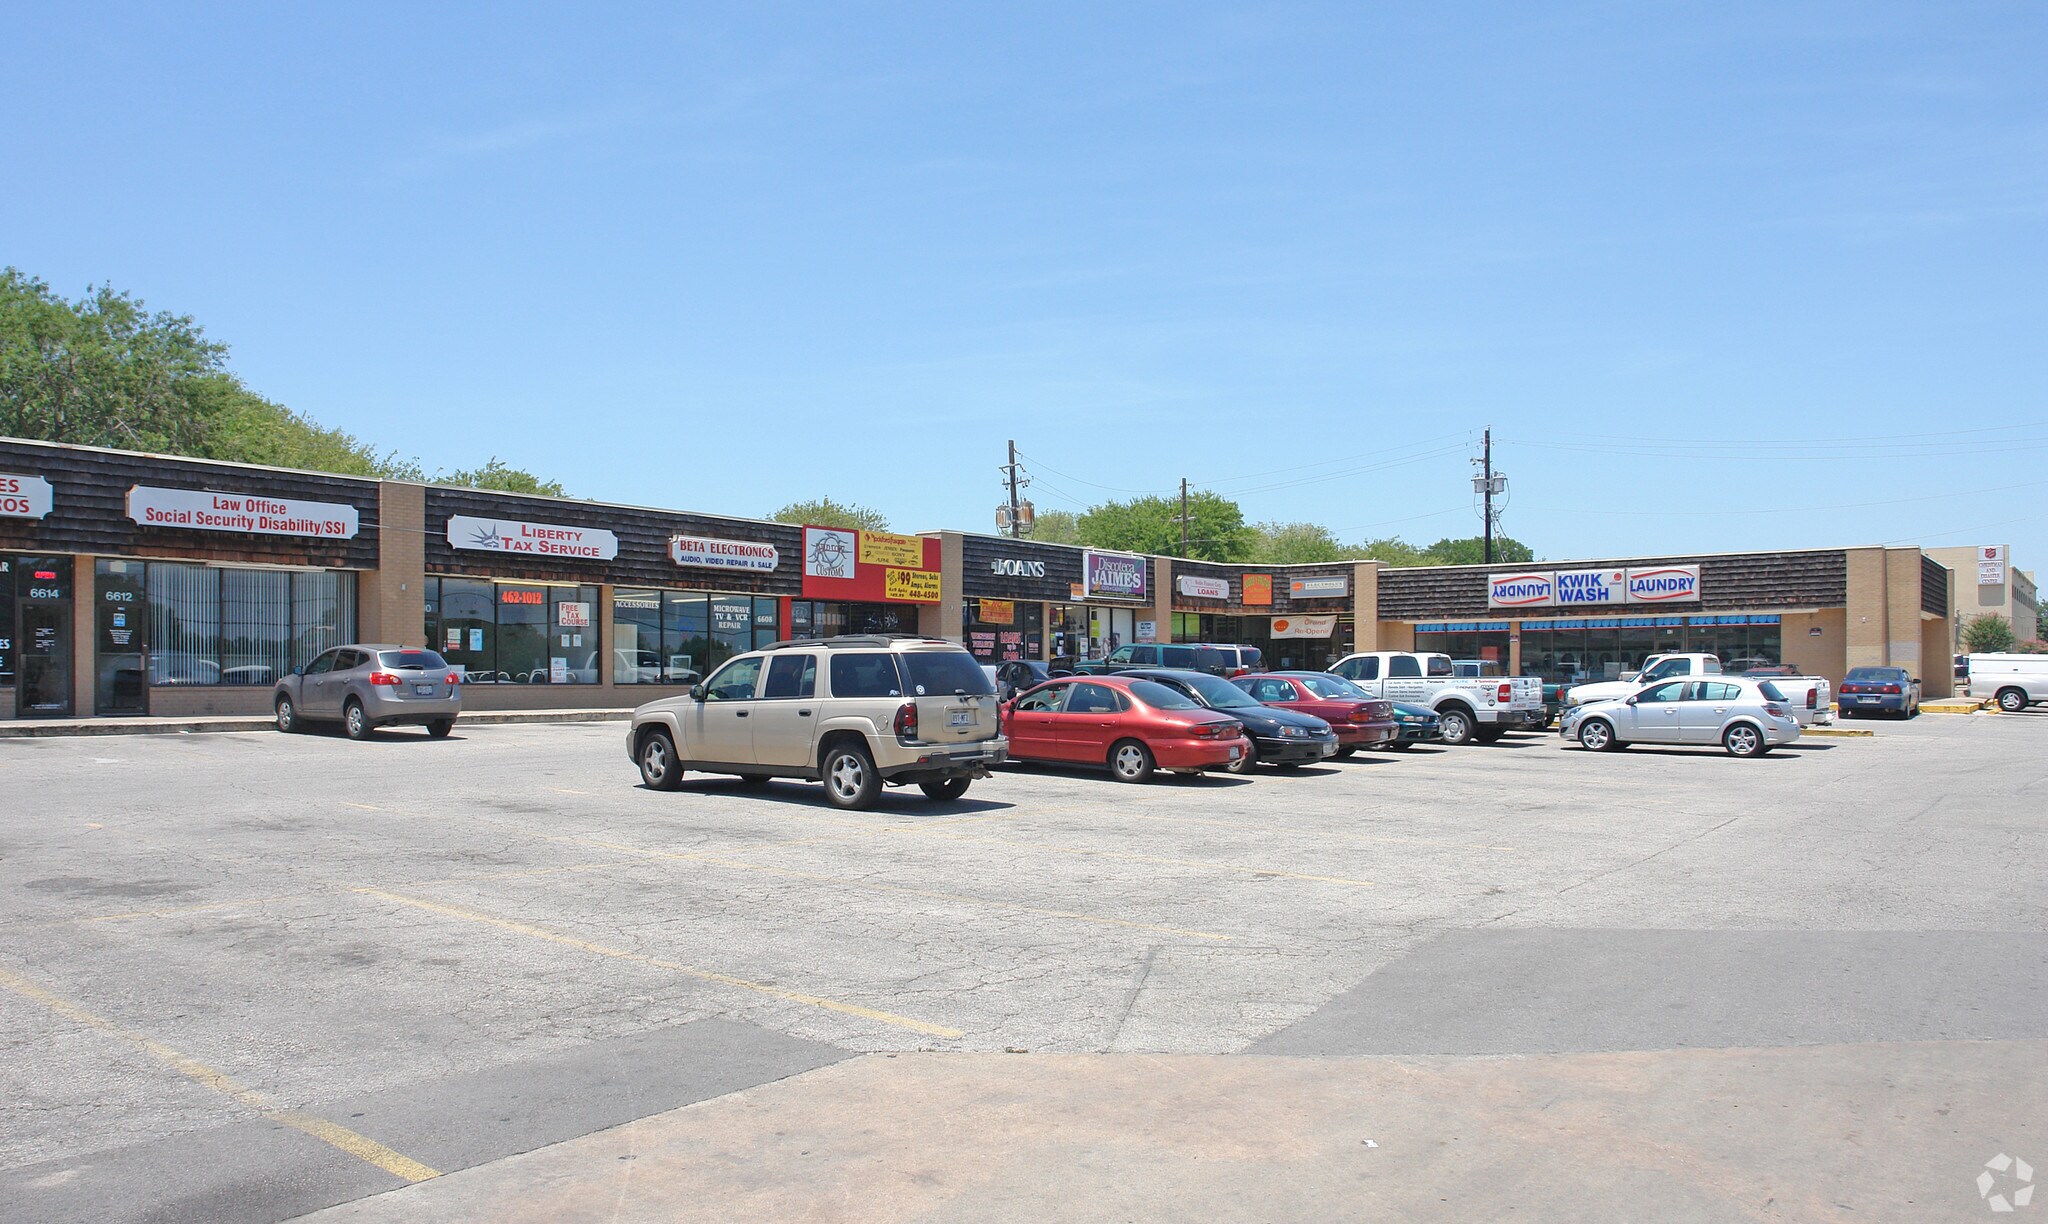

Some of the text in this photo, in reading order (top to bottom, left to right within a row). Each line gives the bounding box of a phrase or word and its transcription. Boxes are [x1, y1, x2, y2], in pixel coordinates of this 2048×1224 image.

[213, 496, 287, 515] Law Office
[146, 507, 346, 536] Social Security Disability/SSI
[521, 524, 583, 542] LIBERTY
[501, 537, 600, 557] TAX SERVICE
[680, 540, 774, 559] BETA ELECTRONICS
[681, 556, 703, 564] AUDIO,
[705, 557, 724, 565] VIDEO
[727, 559, 748, 567] REPAIR
[992, 558, 1045, 578] LOANS
[1098, 557, 1135, 573] Discoteca
[1092, 570, 1142, 588] JAIMES
[1558, 574, 1602, 588] KWIK
[1630, 578, 1696, 592] LAUNDRY
[30, 588, 59, 598] 6614
[106, 591, 133, 602] 6612
[502, 590, 542, 605] 462-1012
[909, 590, 939, 599] 448-4500
[1492, 583, 1551, 598] LAUNDRY
[1558, 587, 1609, 602] WASH
[561, 604, 578, 612] FREE
[615, 601, 660, 610] ACCESSORIES
[714, 605, 750, 614] MICROWAVE
[562, 618, 588, 626] COURSE
[566, 611, 580, 619] TAX
